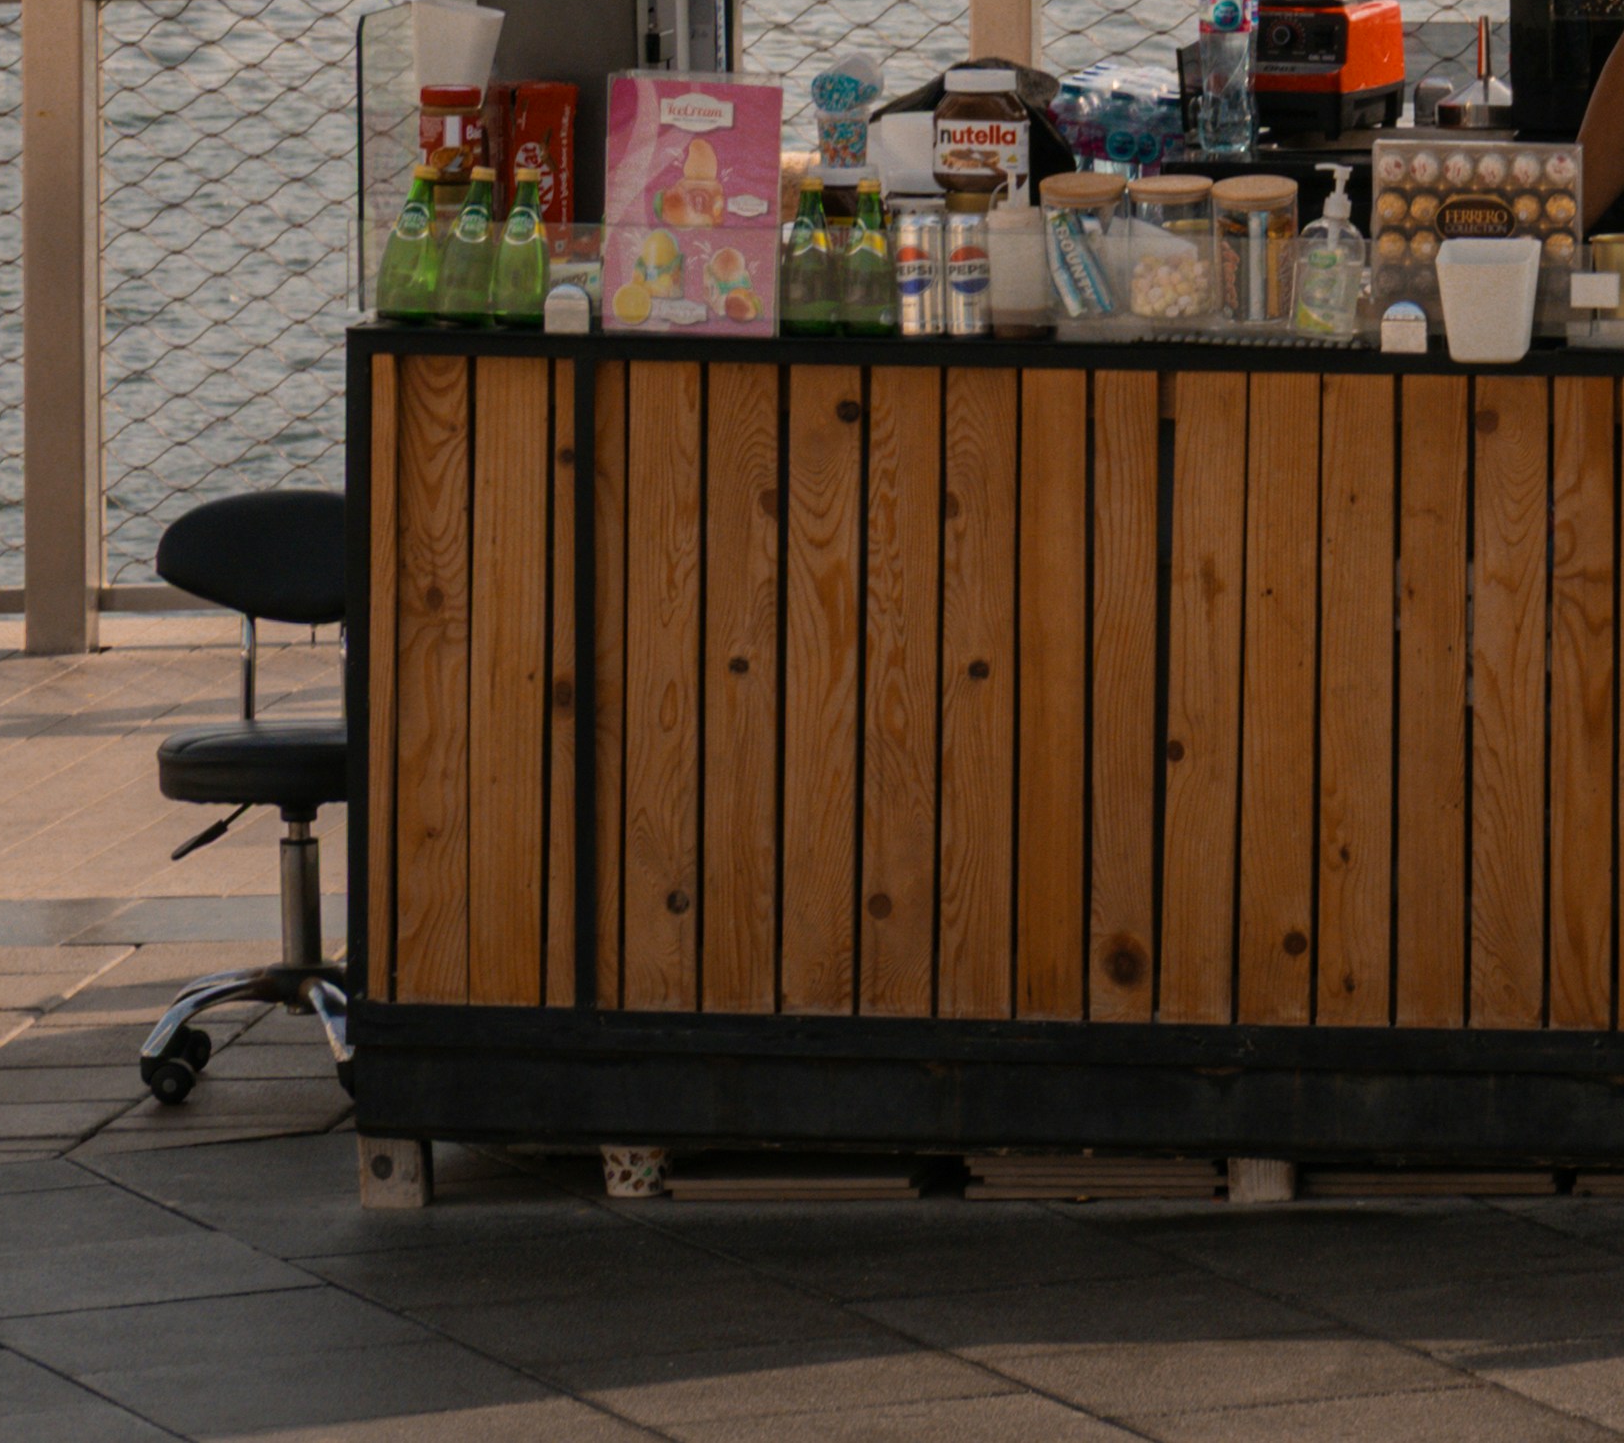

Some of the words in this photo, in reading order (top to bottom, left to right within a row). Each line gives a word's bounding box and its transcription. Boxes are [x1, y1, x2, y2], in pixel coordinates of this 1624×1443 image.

[939, 124, 1017, 147] nutella
[1444, 208, 1509, 224] FERRERO
[1443, 223, 1509, 234] COLLECTION
